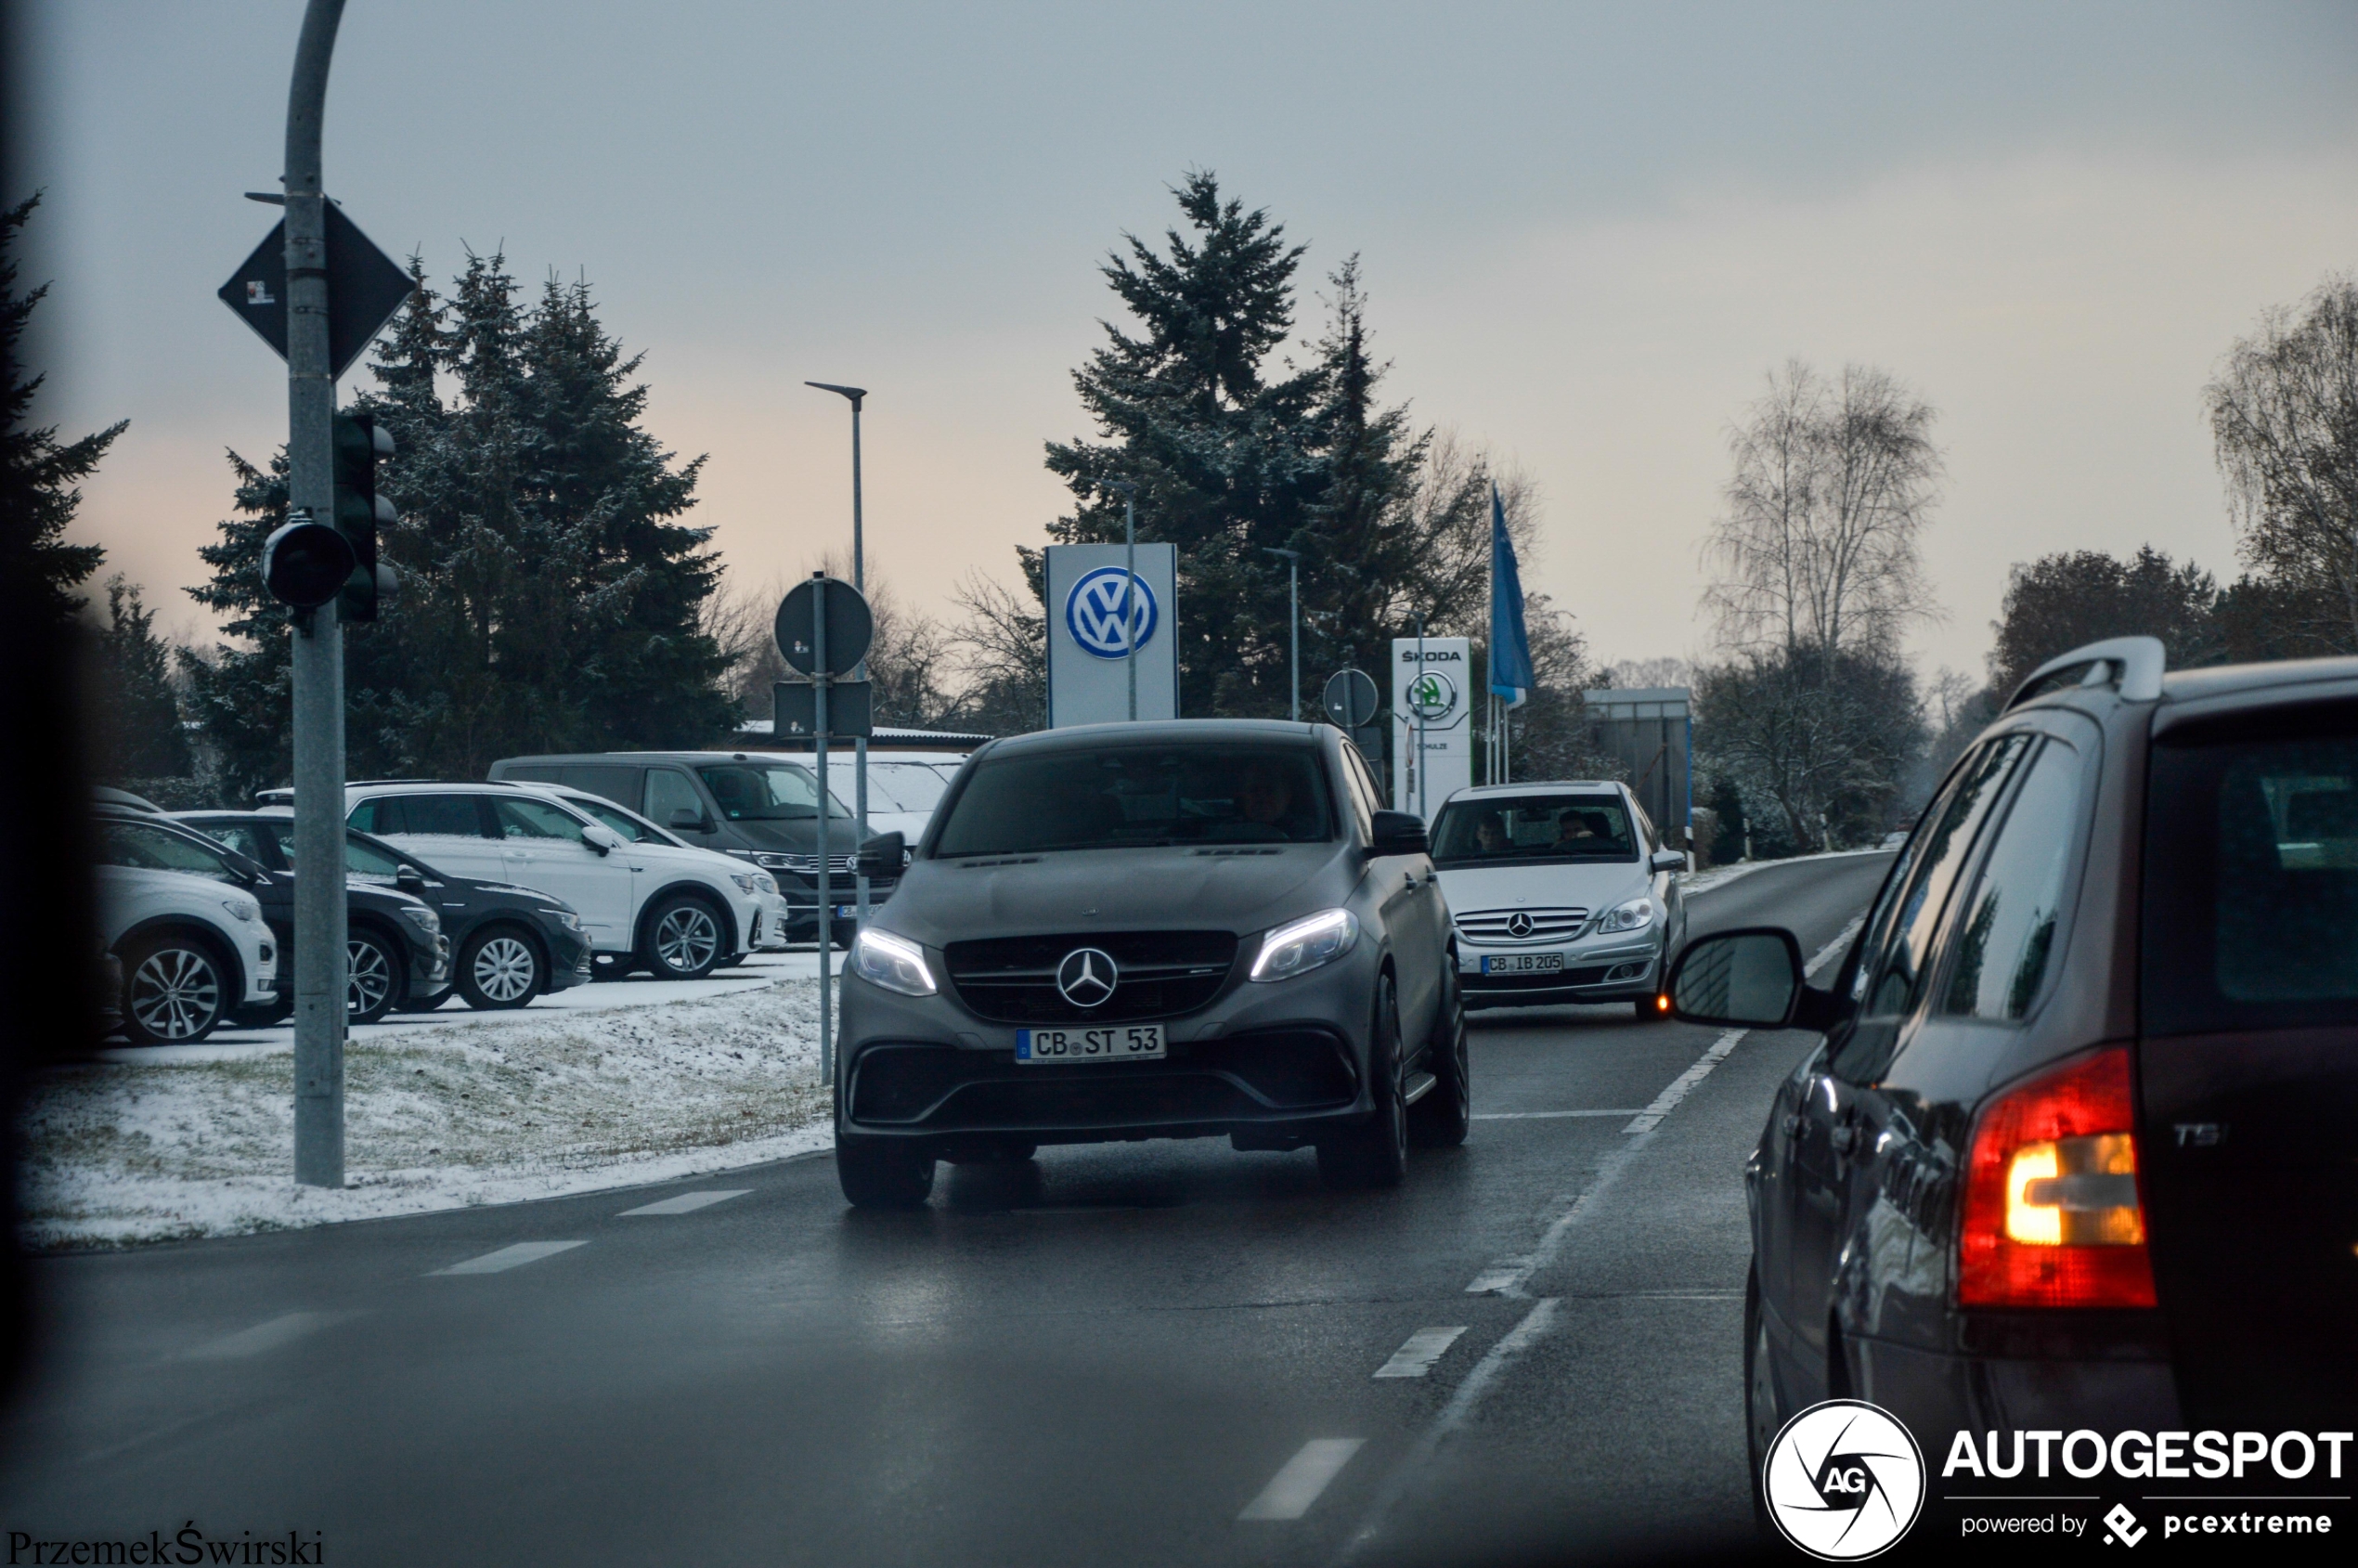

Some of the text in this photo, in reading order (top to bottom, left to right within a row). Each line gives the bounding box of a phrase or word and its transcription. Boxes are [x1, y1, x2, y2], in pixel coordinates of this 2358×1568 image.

[1402, 650, 1461, 662] ŠKODA
[1489, 955, 1561, 971] CB IB 205
[1037, 1031, 1068, 1056] CB
[1084, 1030, 1116, 1055] ST
[1127, 1027, 1159, 1052] 53
